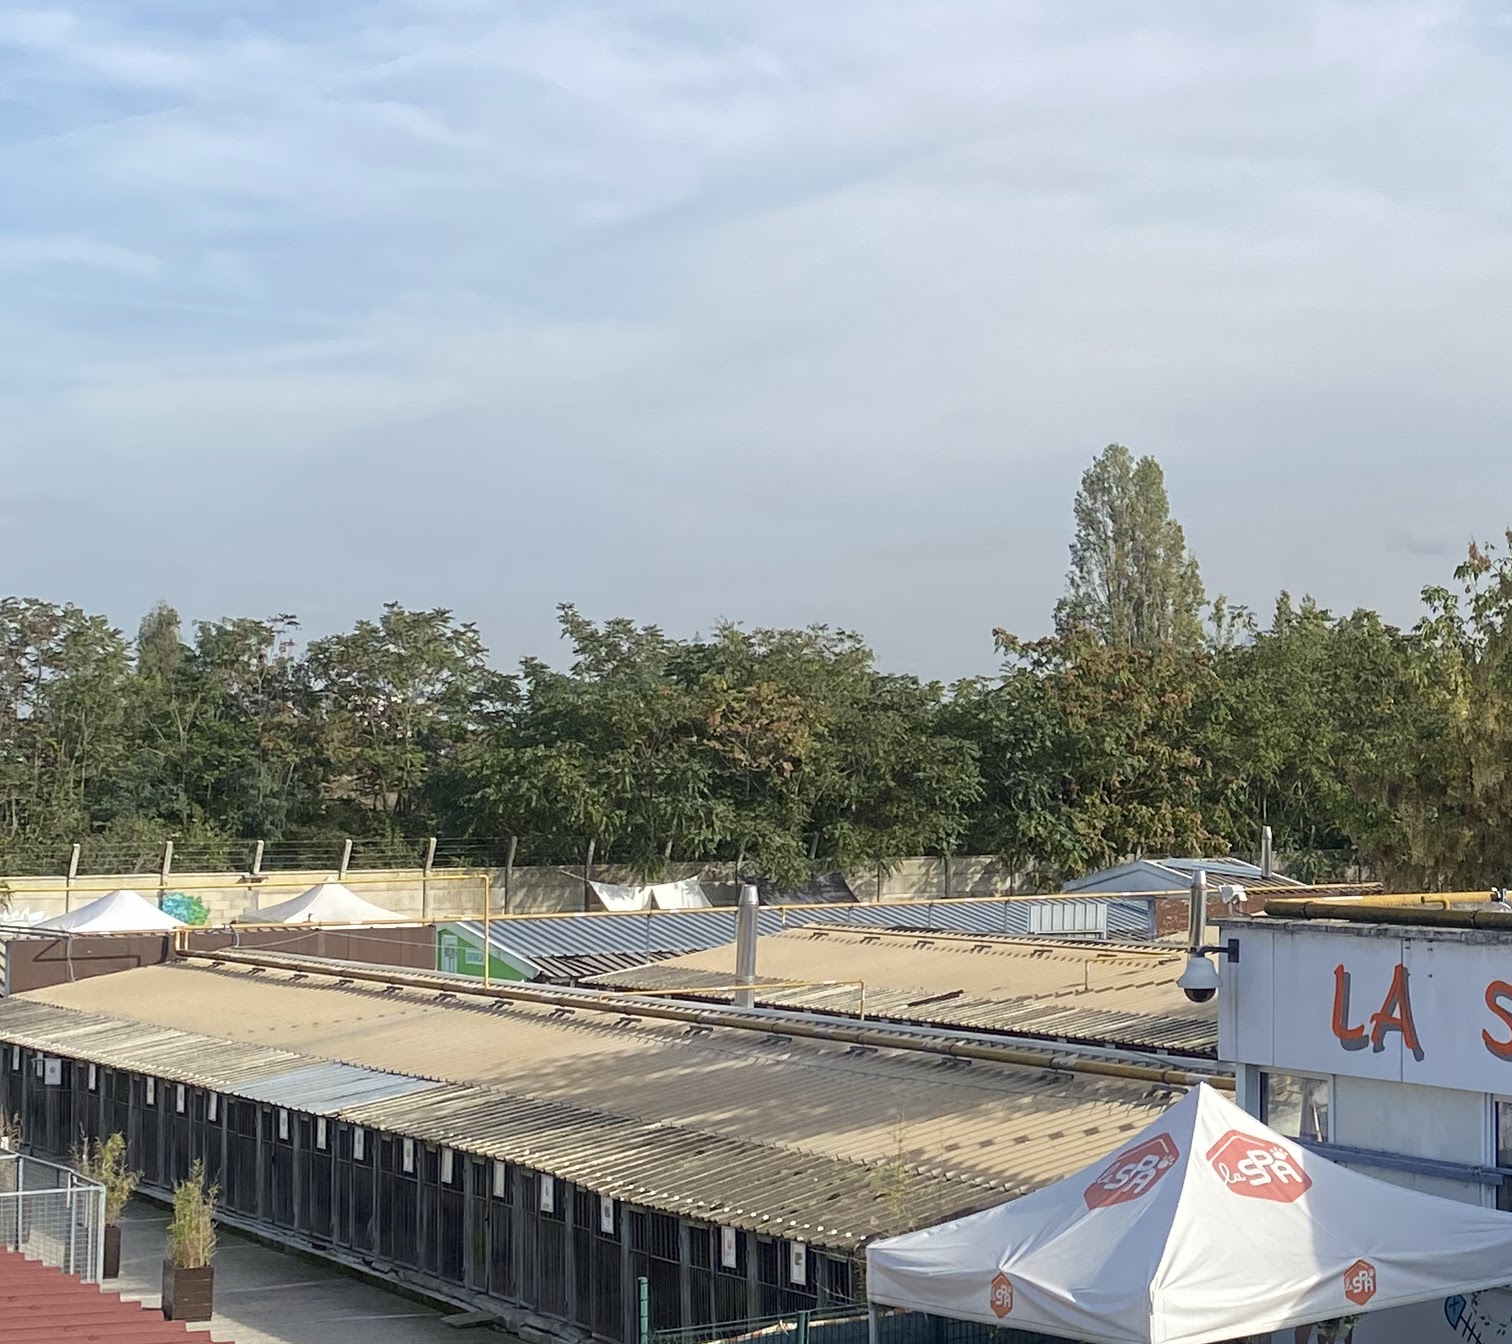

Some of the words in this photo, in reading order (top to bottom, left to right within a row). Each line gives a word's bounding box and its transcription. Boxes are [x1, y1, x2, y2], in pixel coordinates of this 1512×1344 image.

[1332, 963, 1424, 1061] LA
[1102, 1154, 1160, 1194] SPA
[1218, 1162, 1246, 1185] la
[1237, 1149, 1303, 1186] SPA
[1352, 1270, 1374, 1294] SPA
